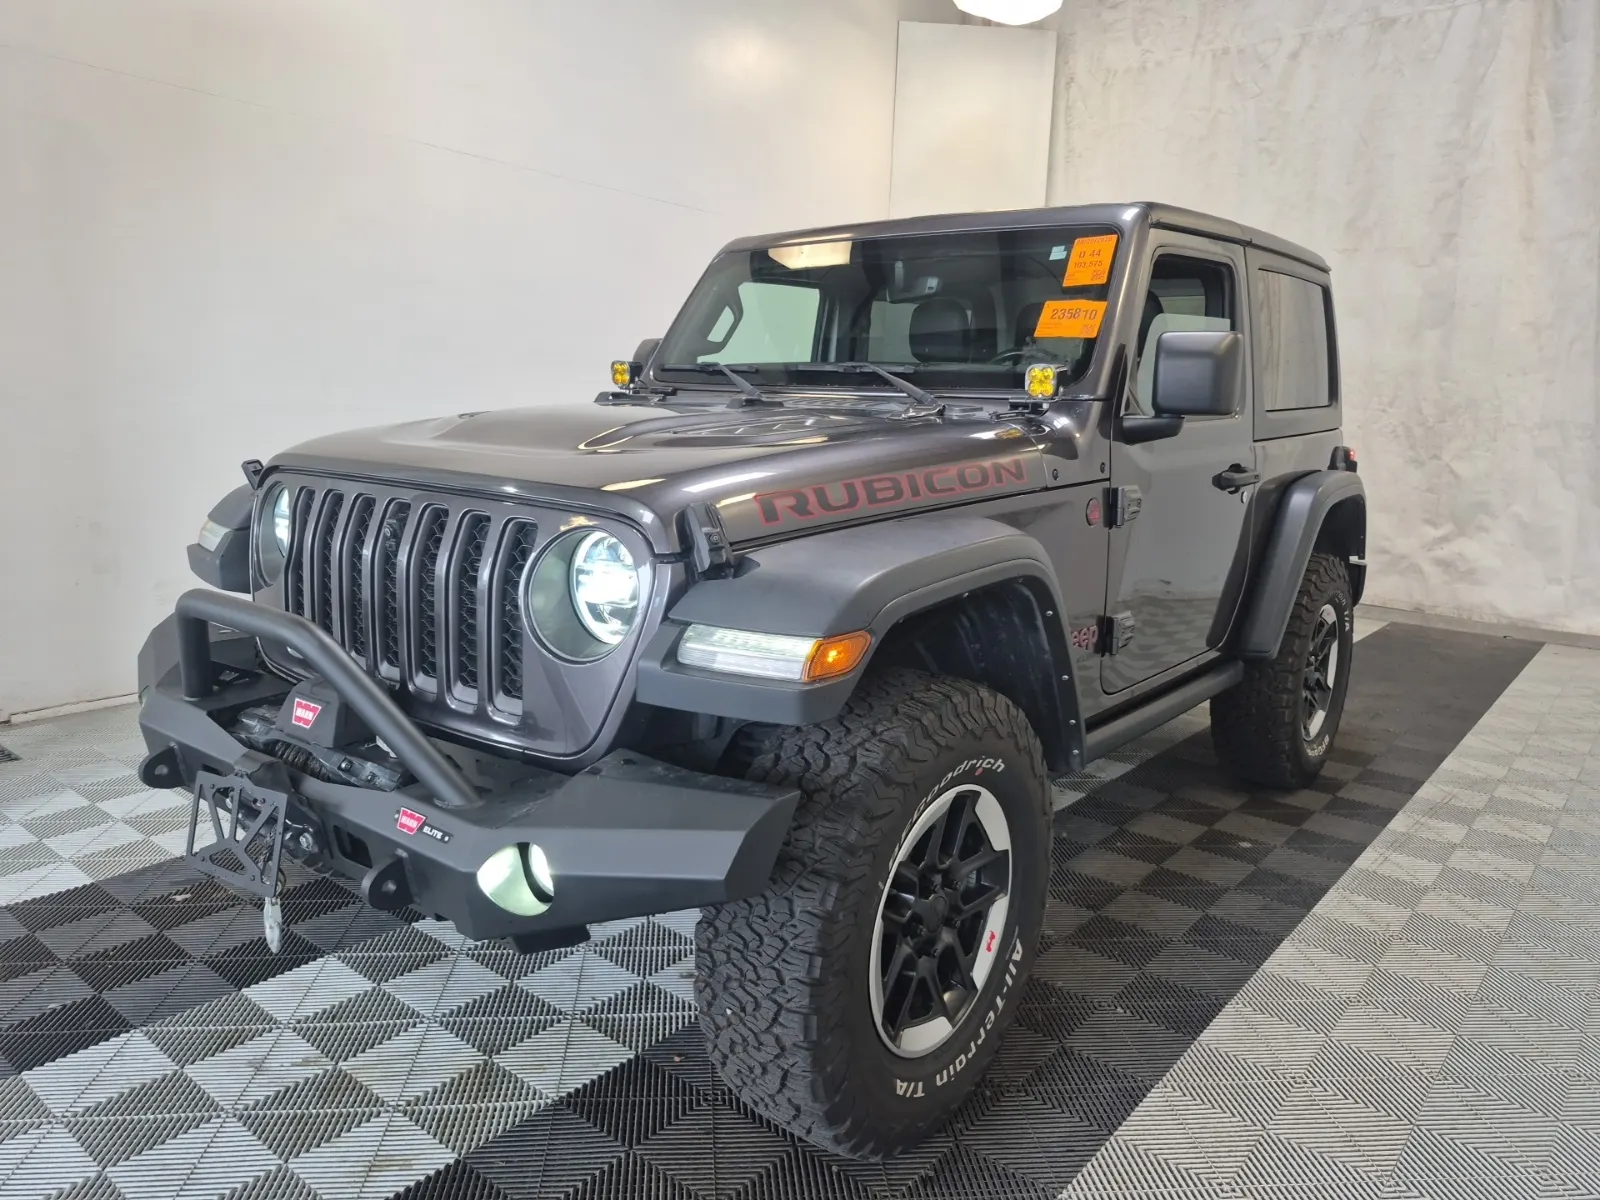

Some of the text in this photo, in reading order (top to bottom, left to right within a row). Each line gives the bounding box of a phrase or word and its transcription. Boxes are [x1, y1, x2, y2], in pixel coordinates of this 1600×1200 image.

[1089, 249, 1102, 258] 44
[1050, 307, 1098, 321] 235810
[753, 457, 1029, 527] RUBICON
[1070, 625, 1098, 650] eep
[422, 825, 443, 840] ELITE
[896, 938, 1023, 1098] All-Terrain T/A
